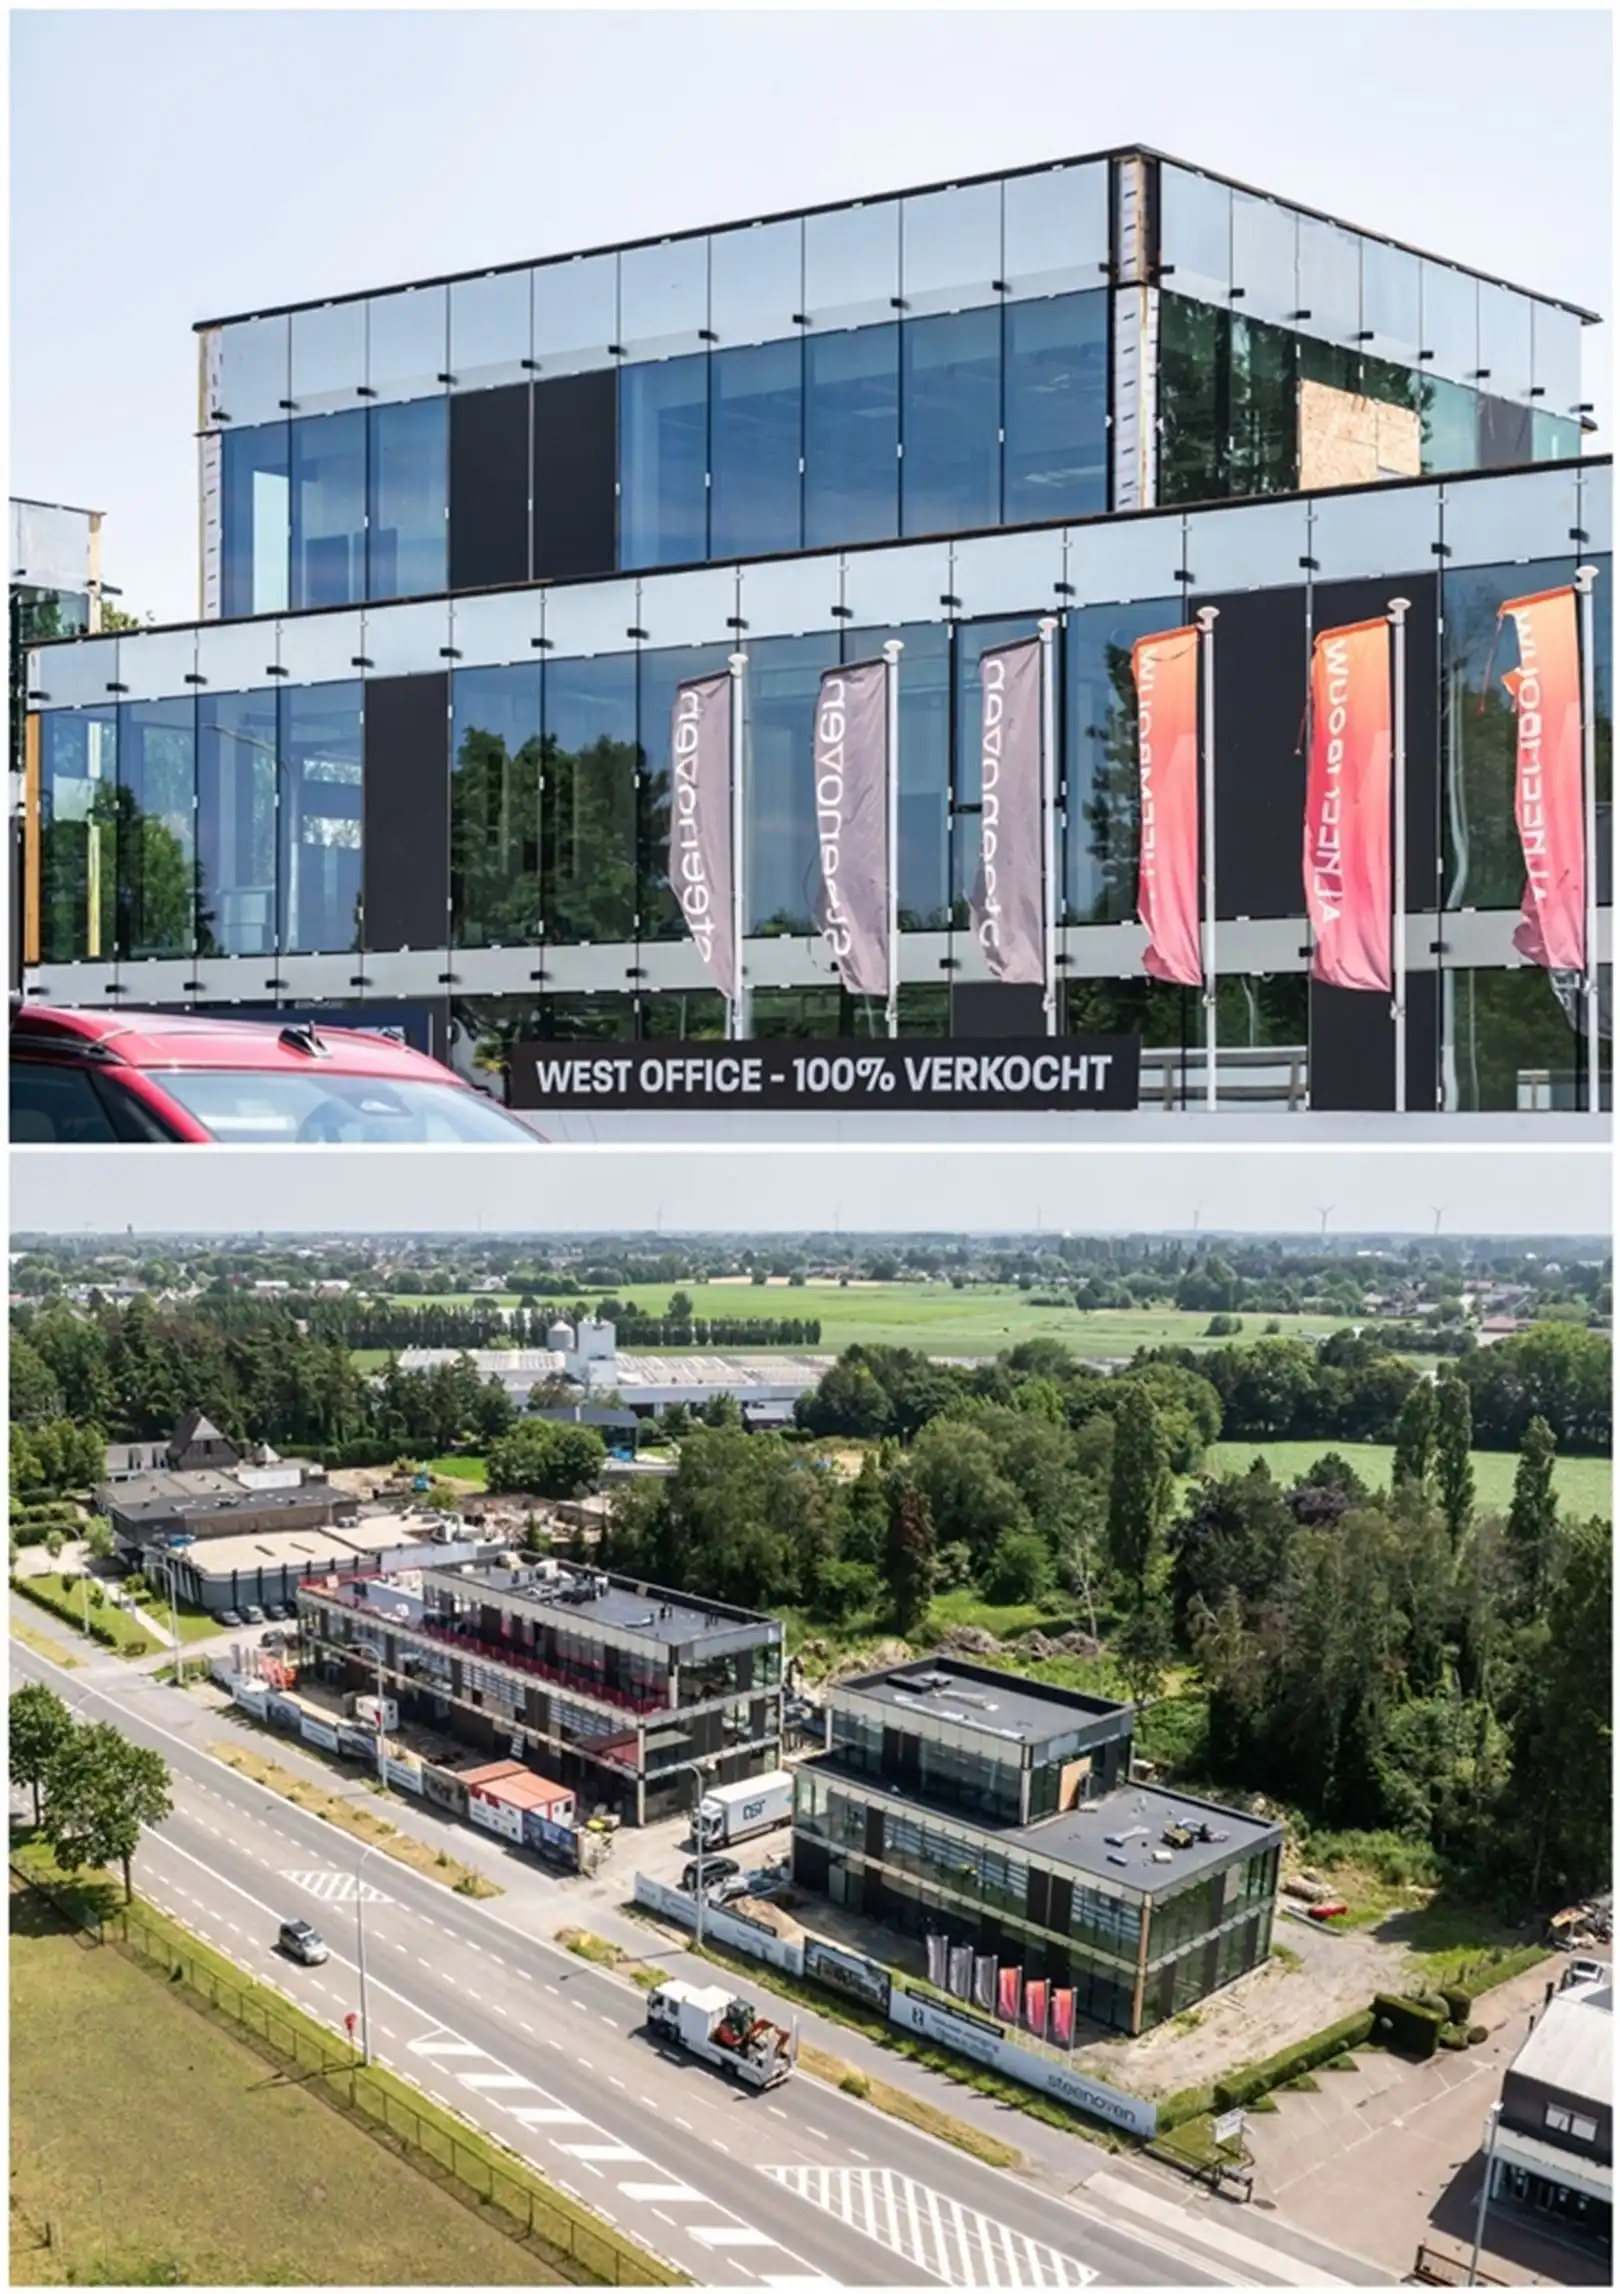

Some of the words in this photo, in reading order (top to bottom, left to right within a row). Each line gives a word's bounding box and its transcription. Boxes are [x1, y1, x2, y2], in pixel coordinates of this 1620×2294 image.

[535, 1059, 632, 1093] WEST
[639, 1058, 762, 1093] OFFICE
[770, 1073, 784, 1081] -
[792, 1057, 896, 1092] 100%
[904, 1055, 1112, 1092] VERKOCHT
